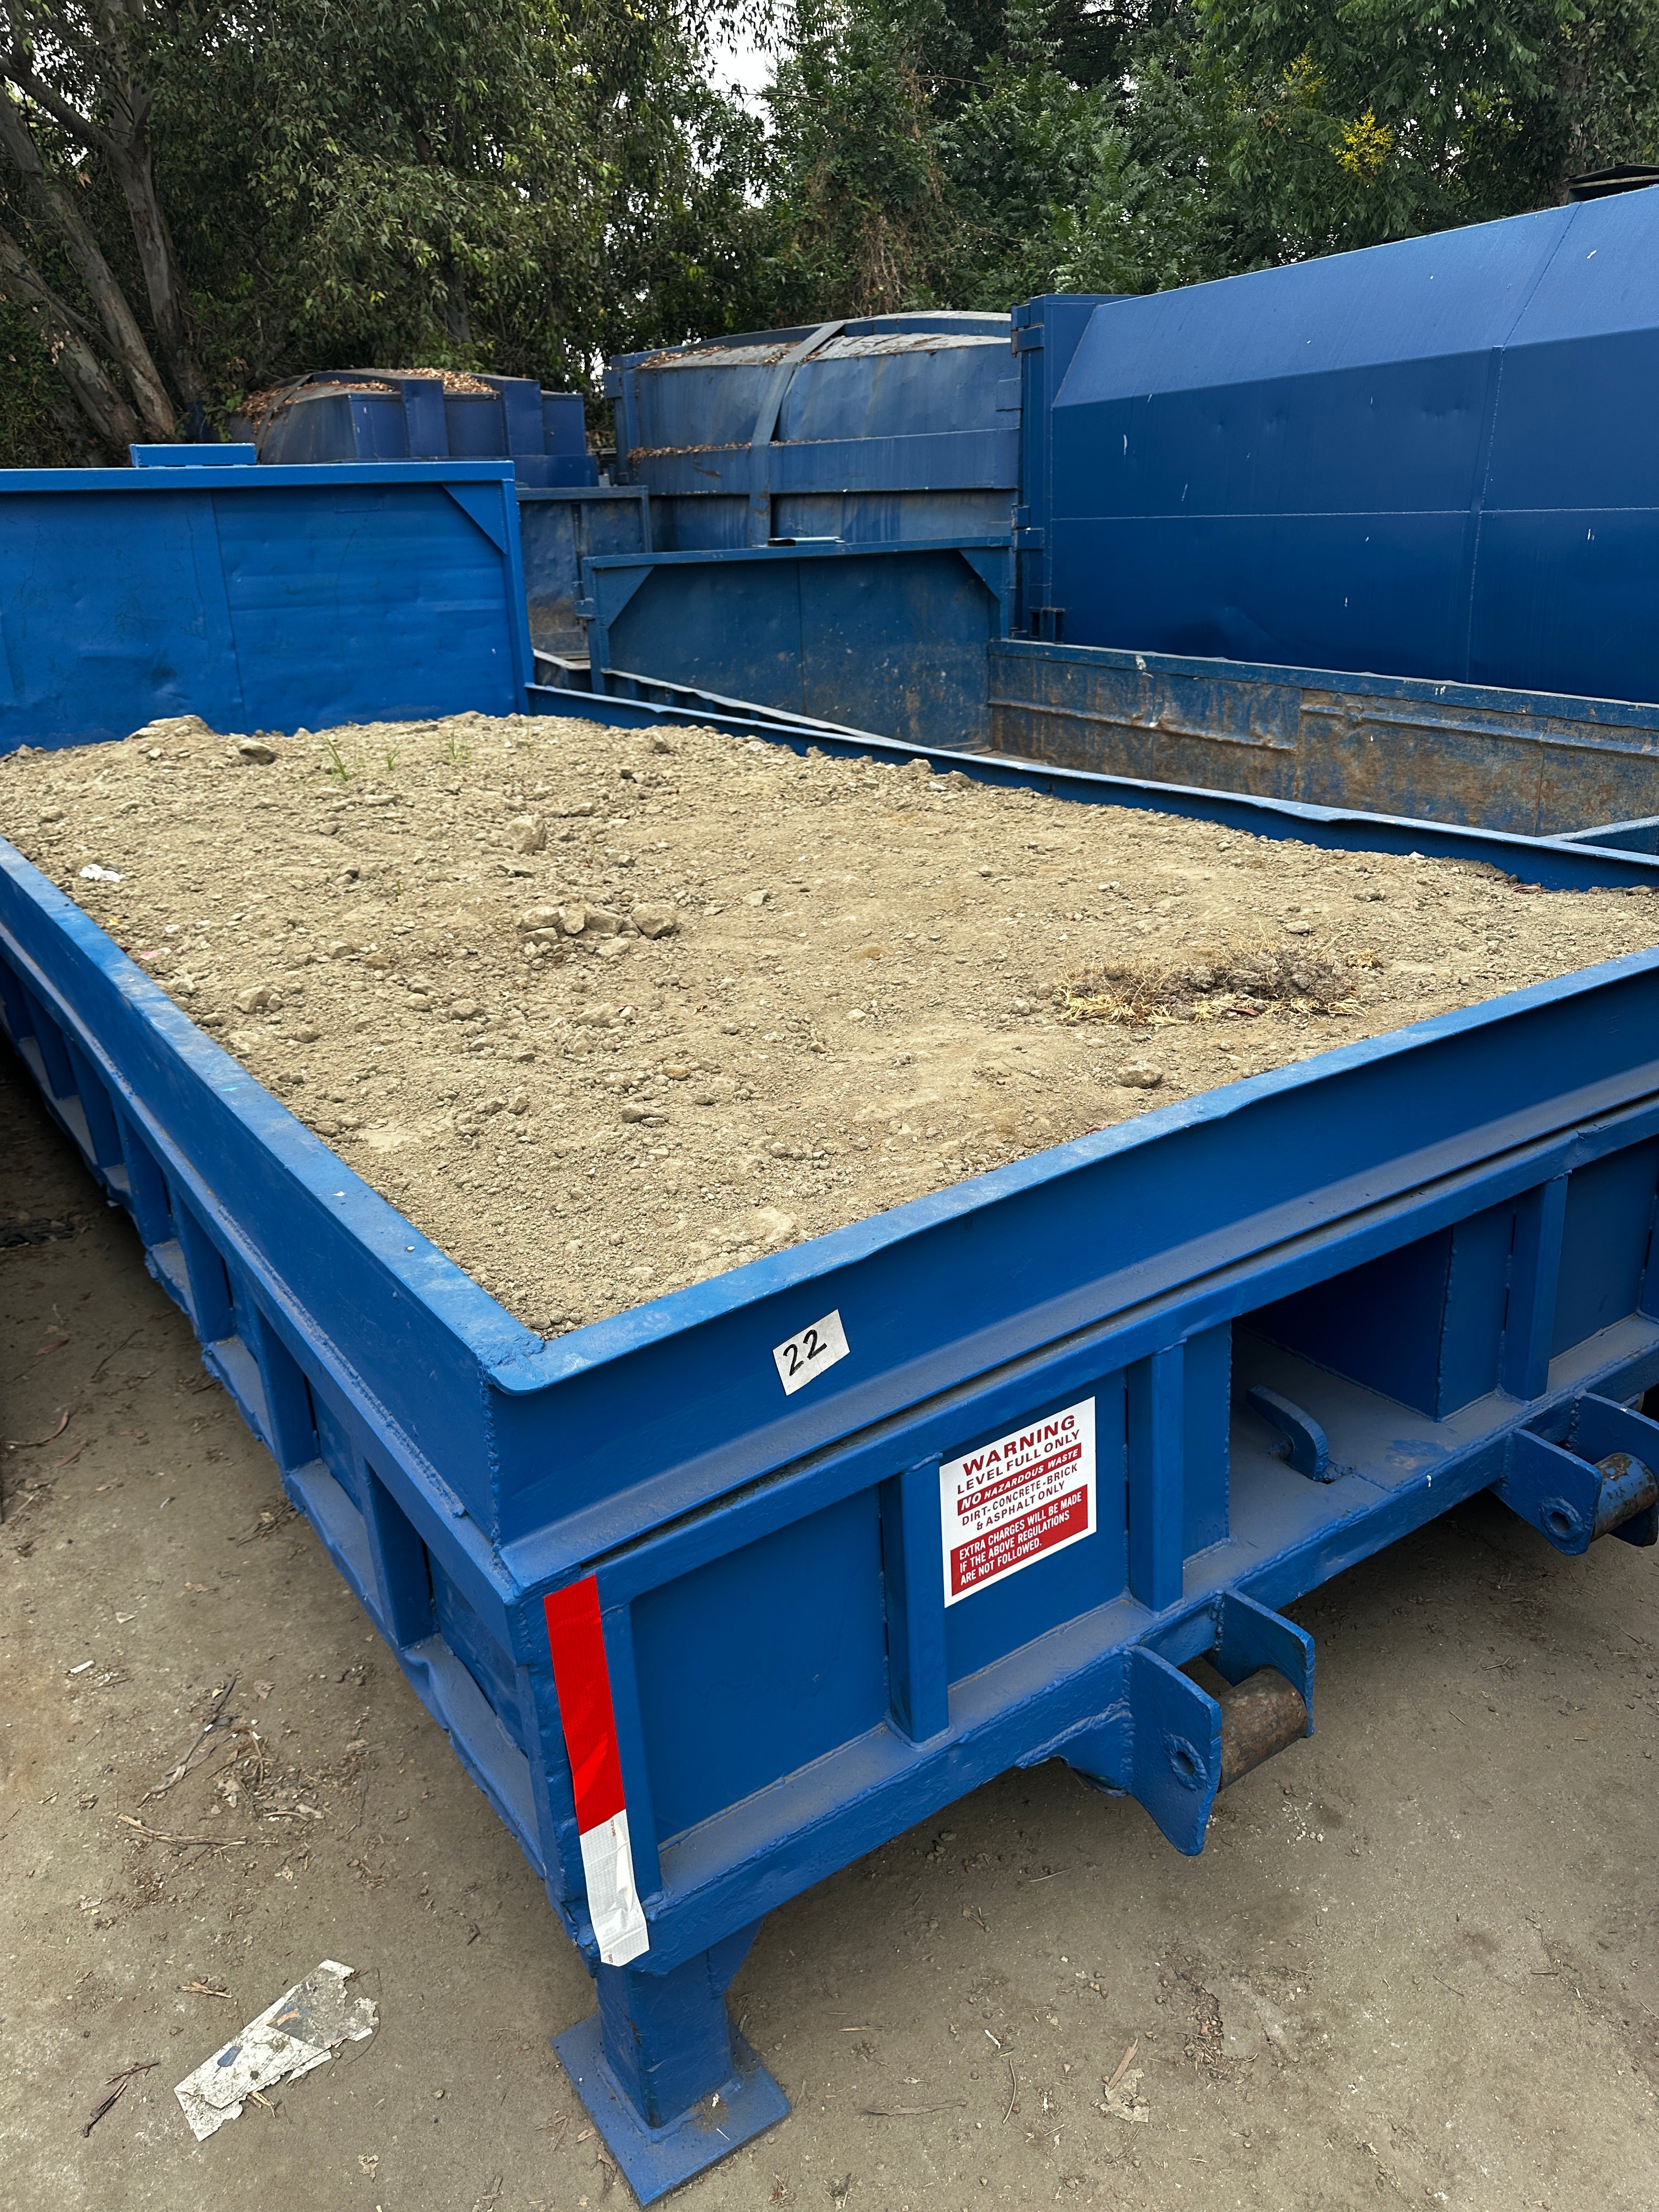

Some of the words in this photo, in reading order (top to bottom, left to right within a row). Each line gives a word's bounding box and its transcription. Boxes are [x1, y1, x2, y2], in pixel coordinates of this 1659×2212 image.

[783, 1329, 827, 1376] 22
[957, 1466, 1003, 1494] LEVEL
[1007, 1452, 1041, 1471] FULL
[1044, 1429, 1080, 1453] ONLY
[962, 1415, 1075, 1476] WARNING
[961, 1492, 981, 1511] NO
[984, 1465, 1044, 1500] HAZARDOUS
[1048, 1448, 1079, 1469] WASTE
[962, 1463, 1077, 1526] DIRT-CONCRETE-BRICK
[977, 1522, 984, 1531] &
[986, 1495, 1035, 1527] ASPHALT
[1038, 1480, 1065, 1500] ONLY
[960, 1539, 986, 1560] EXTRA
[988, 1519, 1025, 1546] CHARGES
[1027, 1509, 1046, 1527] WILL
[1048, 1503, 1059, 1515] BE
[1060, 1491, 1082, 1510] MADE
[960, 1561, 967, 1573] IF
[969, 1553, 986, 1568] THE
[988, 1537, 1015, 1559] ABOVE
[1018, 1510, 1070, 1543] REGULATIONS
[961, 1571, 977, 1585] ARE
[978, 1560, 995, 1577] NOT
[997, 1537, 1042, 1567] FOLLOWED.
